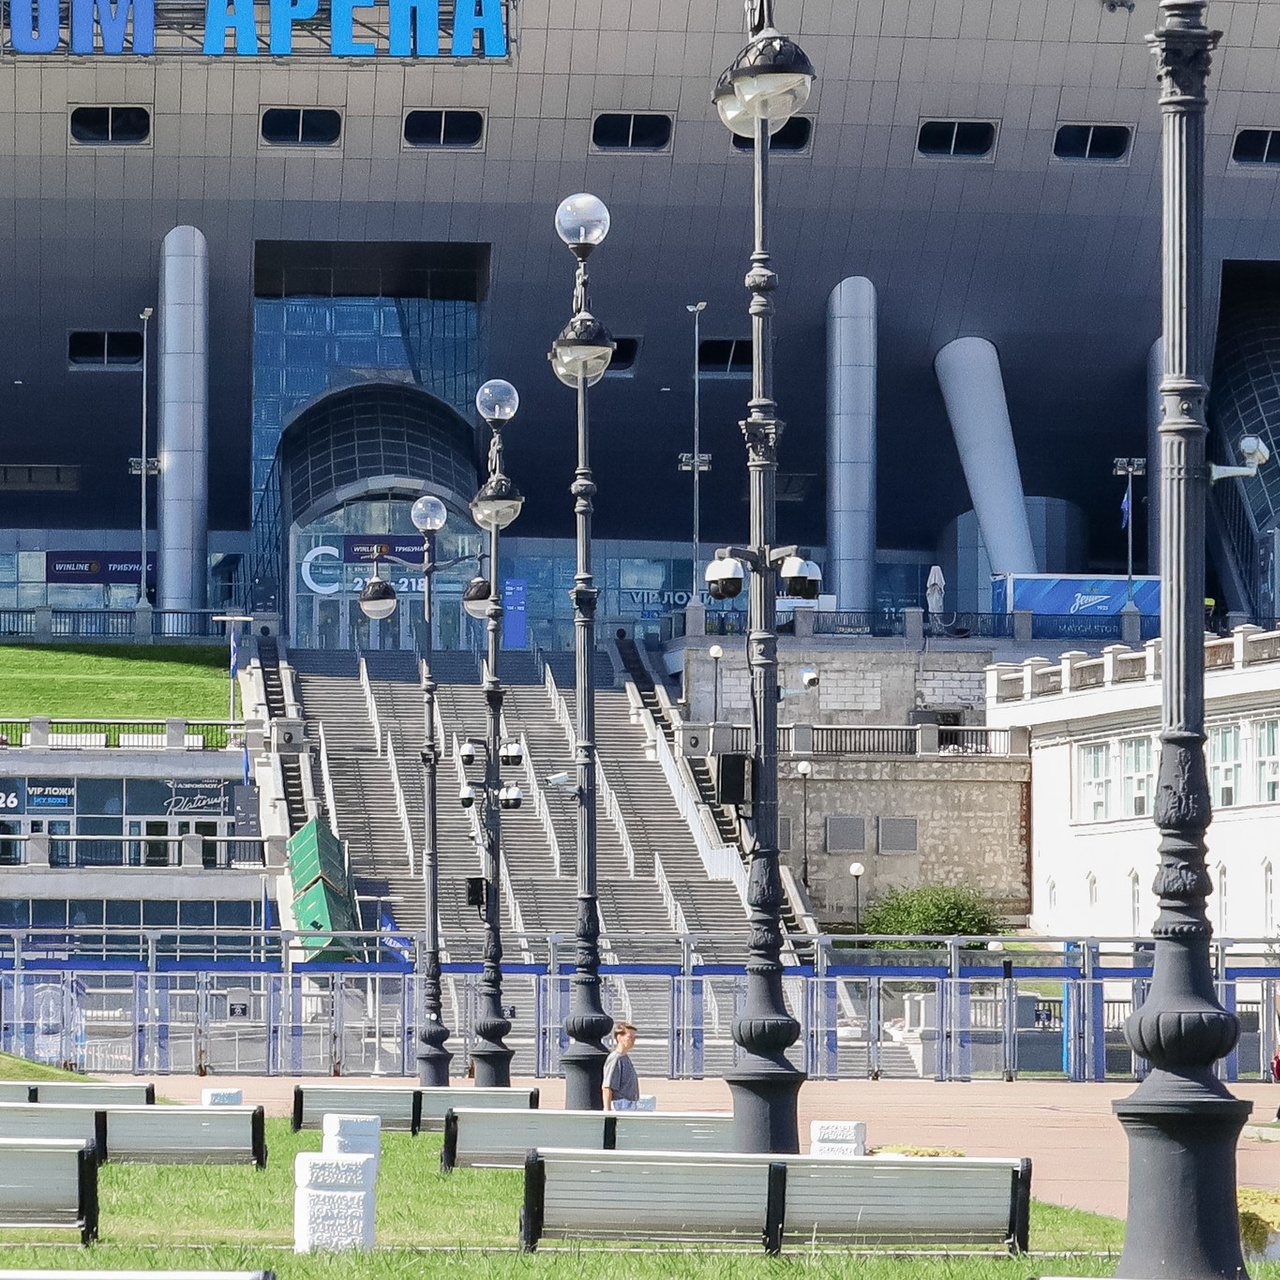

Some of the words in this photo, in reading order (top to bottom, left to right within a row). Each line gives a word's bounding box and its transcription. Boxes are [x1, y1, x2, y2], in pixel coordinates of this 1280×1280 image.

[55, 563, 90, 571] WINLINE
[27, 786, 44, 796] VIP
[44, 786, 75, 796] ЛОЖИ
[163, 789, 230, 816] Platinum
